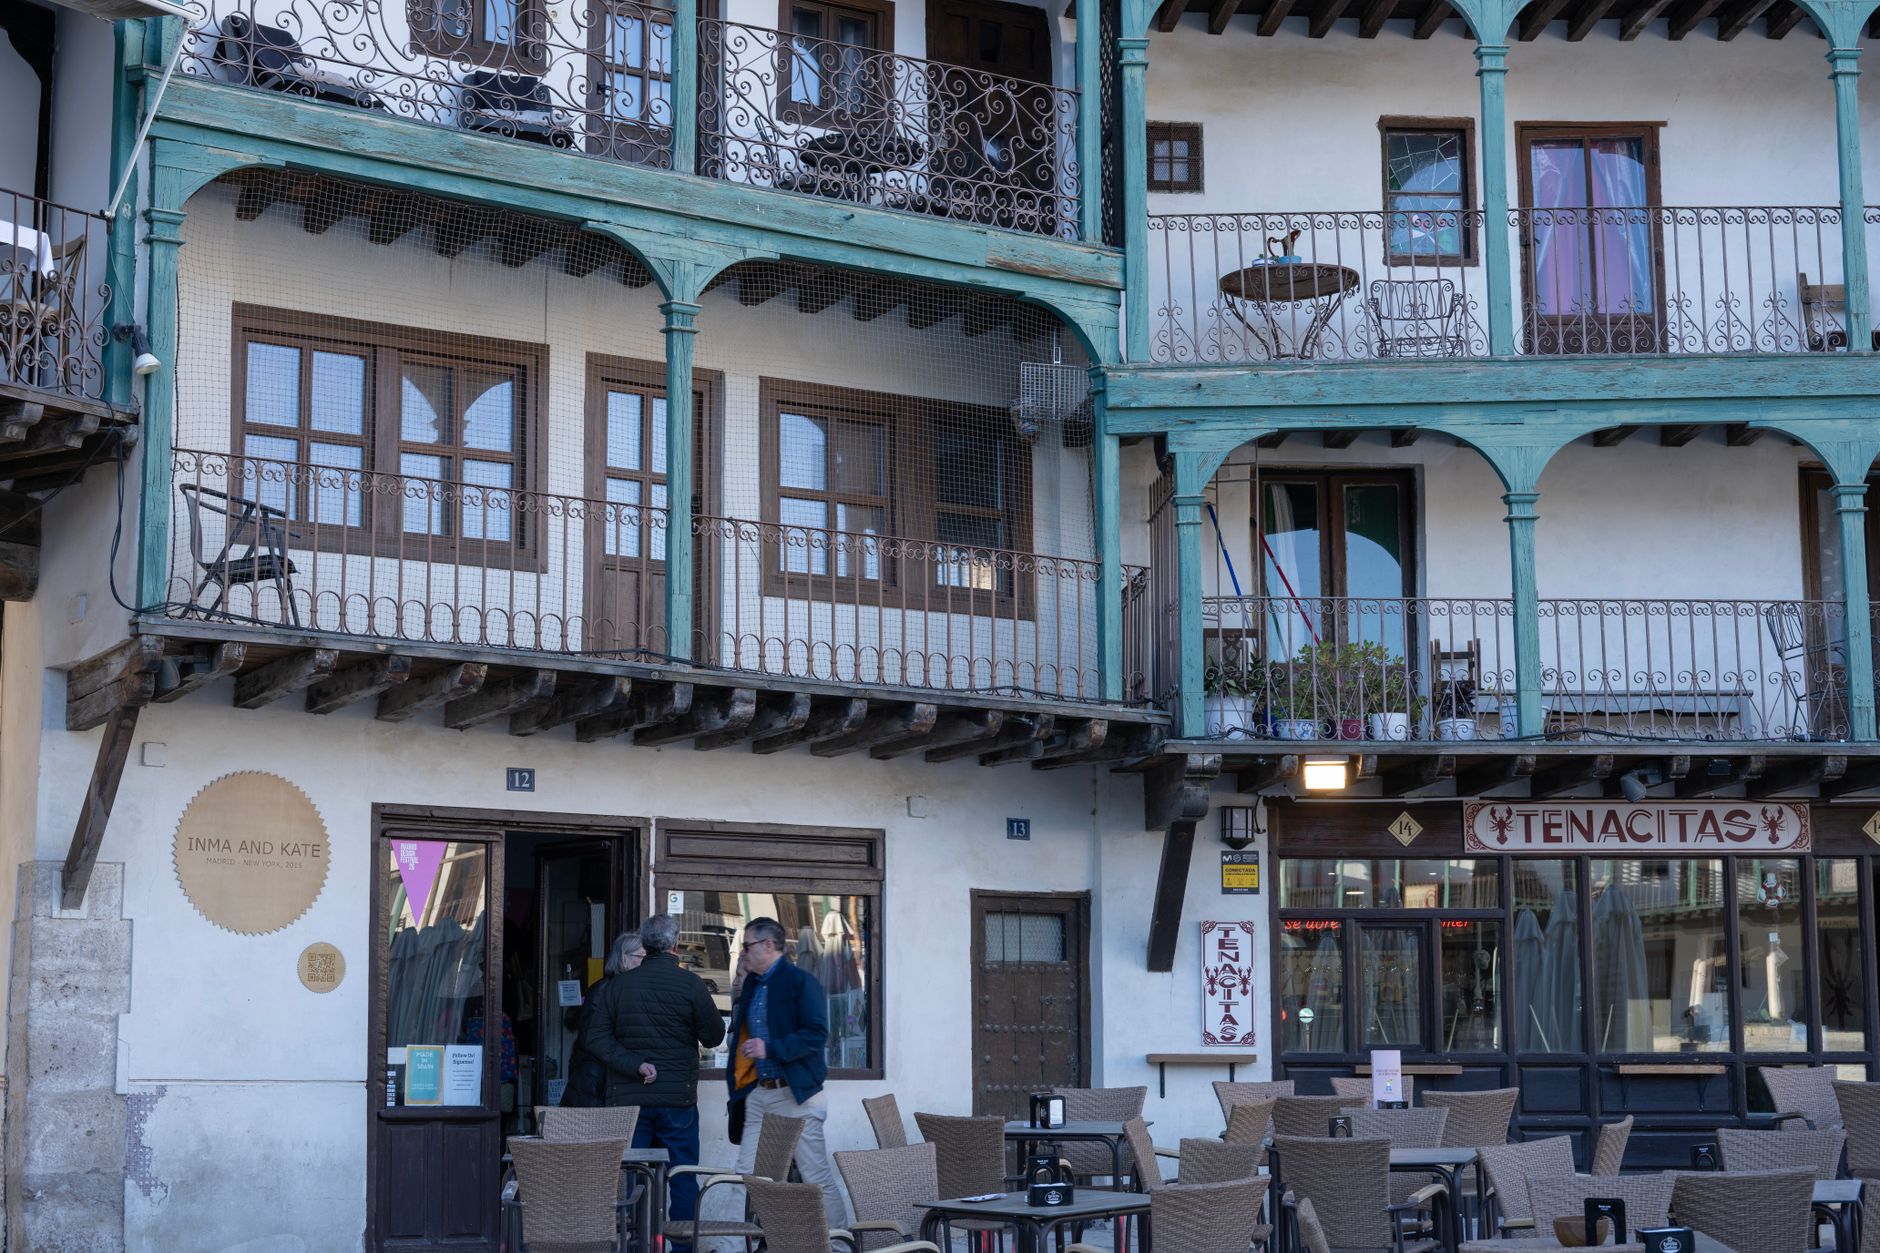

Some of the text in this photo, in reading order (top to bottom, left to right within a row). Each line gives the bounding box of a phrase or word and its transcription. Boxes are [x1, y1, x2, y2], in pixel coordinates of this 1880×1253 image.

[513, 771, 530, 788] 12
[1013, 822, 1026, 837] 13
[1398, 820, 1413, 837] 14
[1516, 809, 1758, 844] TENACITAS
[1873, 819, 1880, 834] 1
[187, 837, 321, 858] INMA AND KATE
[206, 857, 236, 866] MADRID
[243, 859, 260, 867] NEW
[1217, 926, 1240, 1042] TENACITAS
